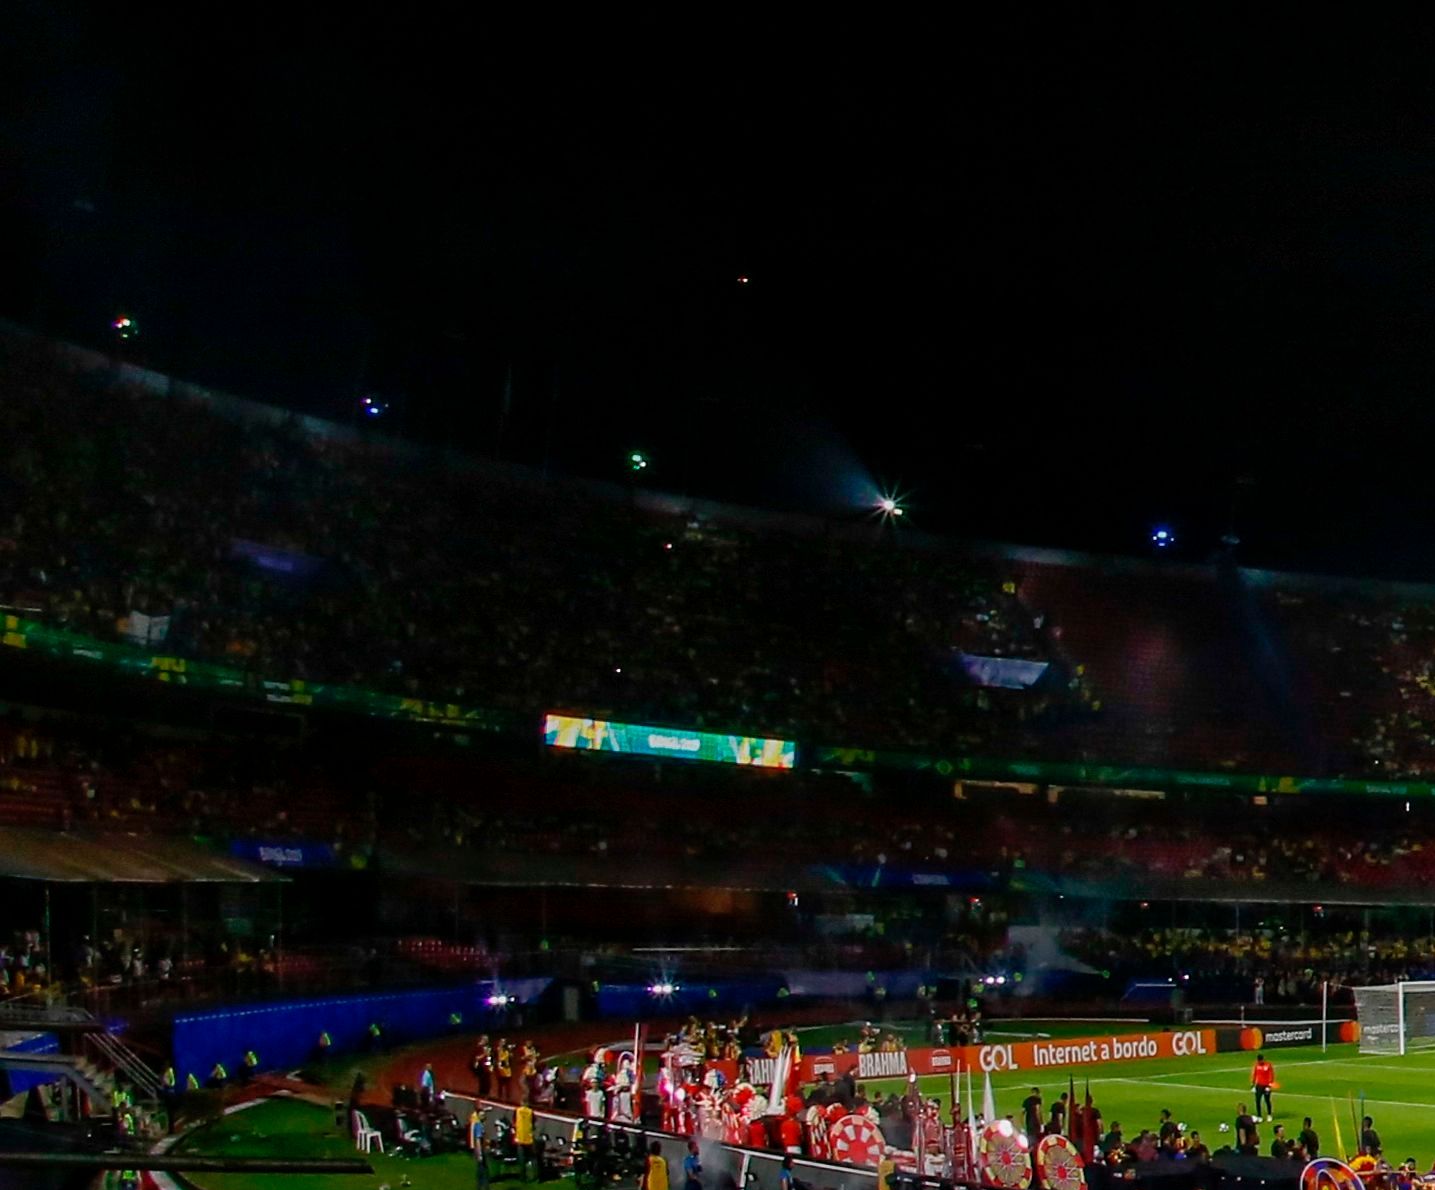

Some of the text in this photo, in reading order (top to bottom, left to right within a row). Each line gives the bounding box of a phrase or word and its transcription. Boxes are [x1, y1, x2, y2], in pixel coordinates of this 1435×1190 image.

[1264, 1028, 1313, 1043] mastercard
[859, 1051, 909, 1076] BRAHMA
[979, 1044, 1019, 1071] GOL
[1033, 1041, 1098, 1067] Internet
[1100, 1044, 1110, 1061] a
[1113, 1034, 1157, 1060] bordo
[1172, 1031, 1206, 1055] GOL
